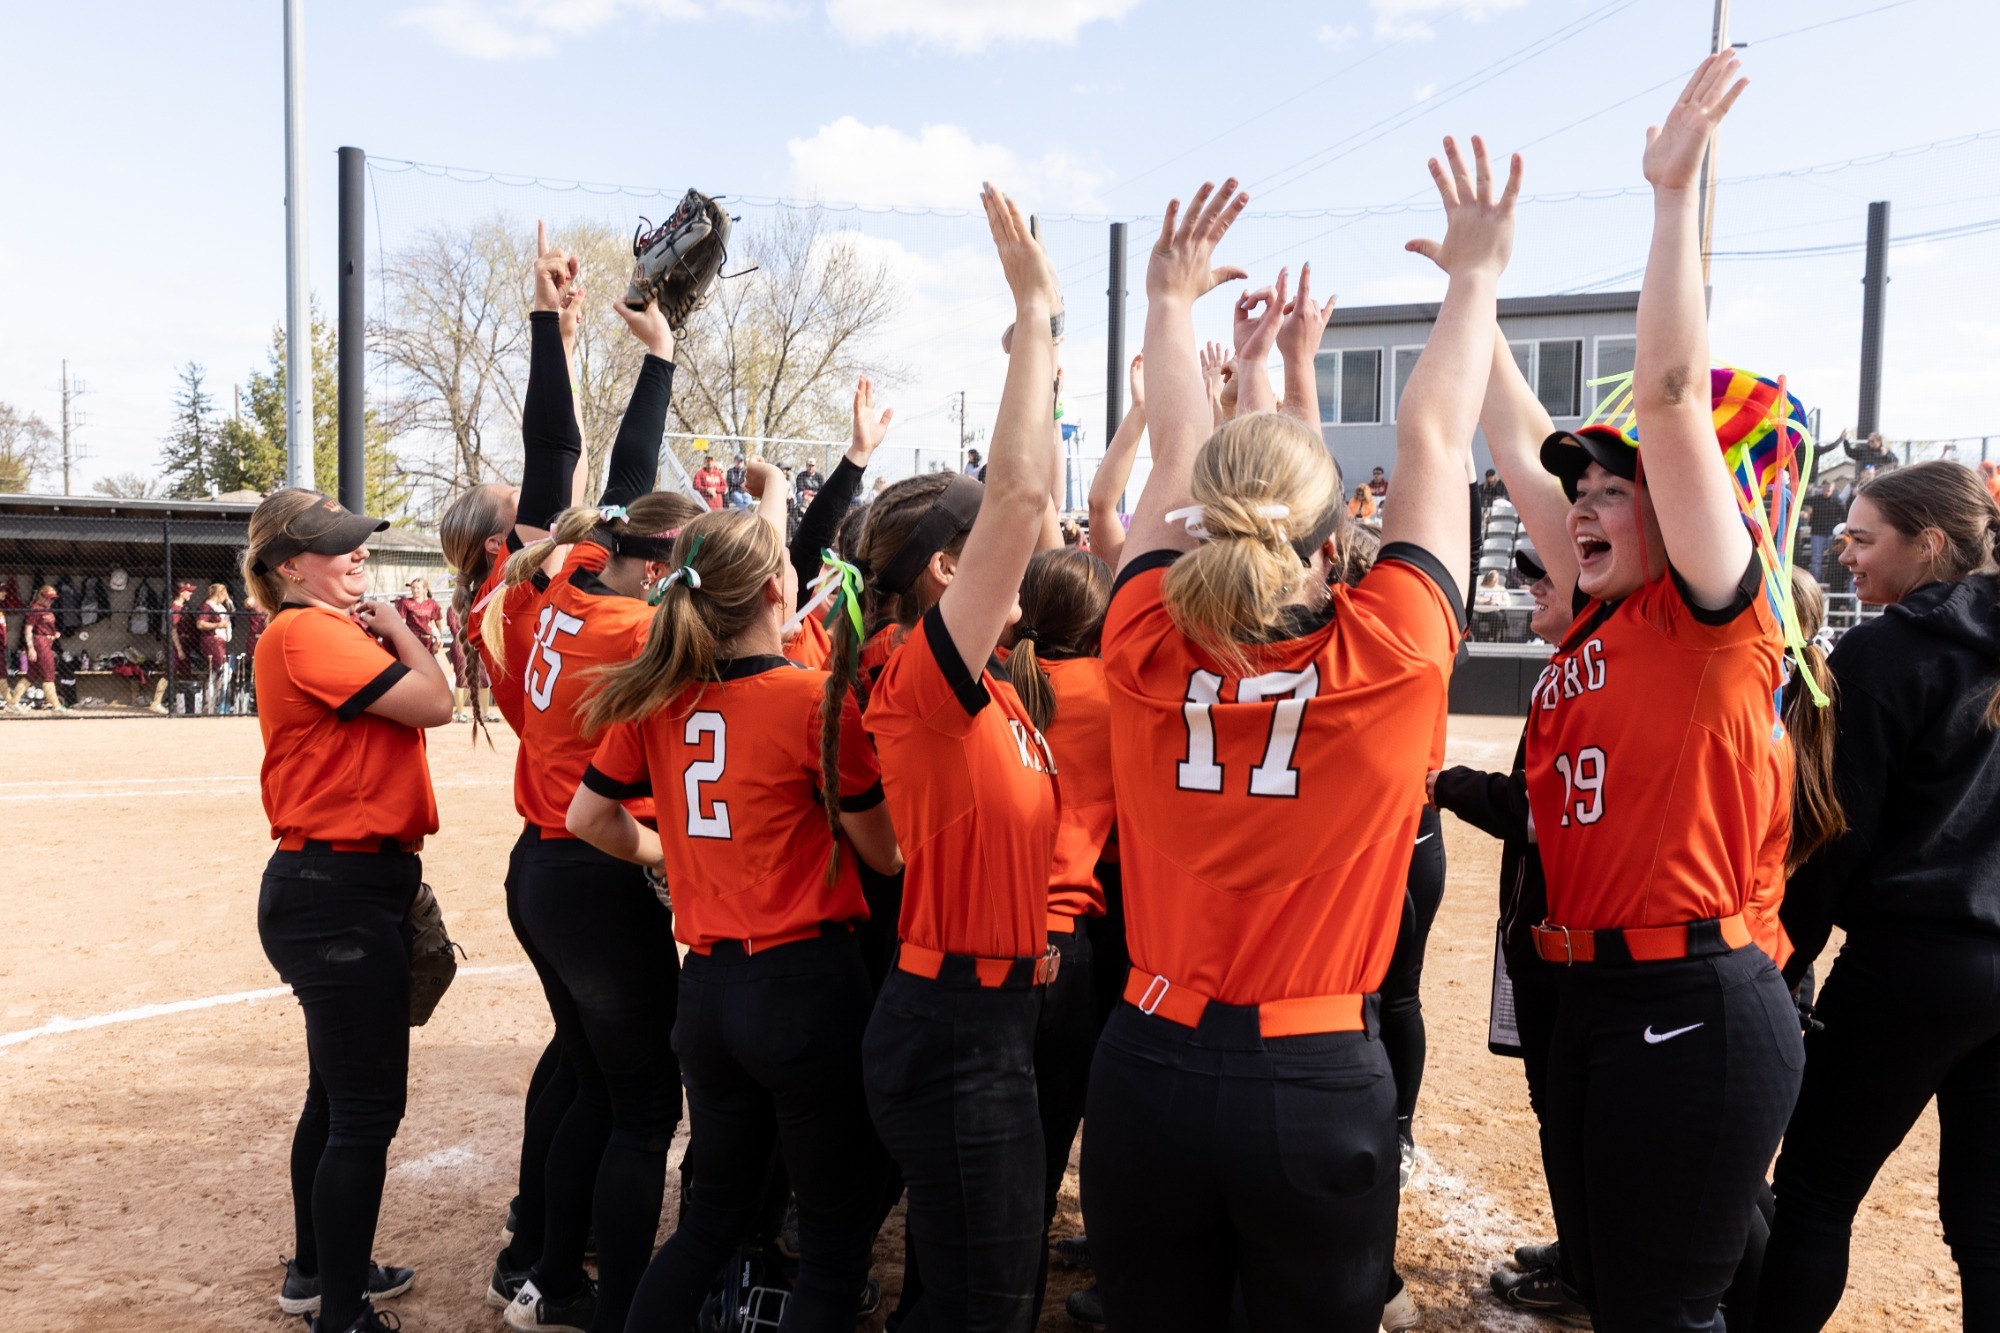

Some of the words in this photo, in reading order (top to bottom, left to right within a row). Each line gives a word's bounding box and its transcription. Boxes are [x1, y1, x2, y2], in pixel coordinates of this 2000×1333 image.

[523, 602, 586, 713] 15
[683, 709, 732, 840] 2
[1176, 660, 1320, 798] 17
[1554, 745, 1607, 828] 19
